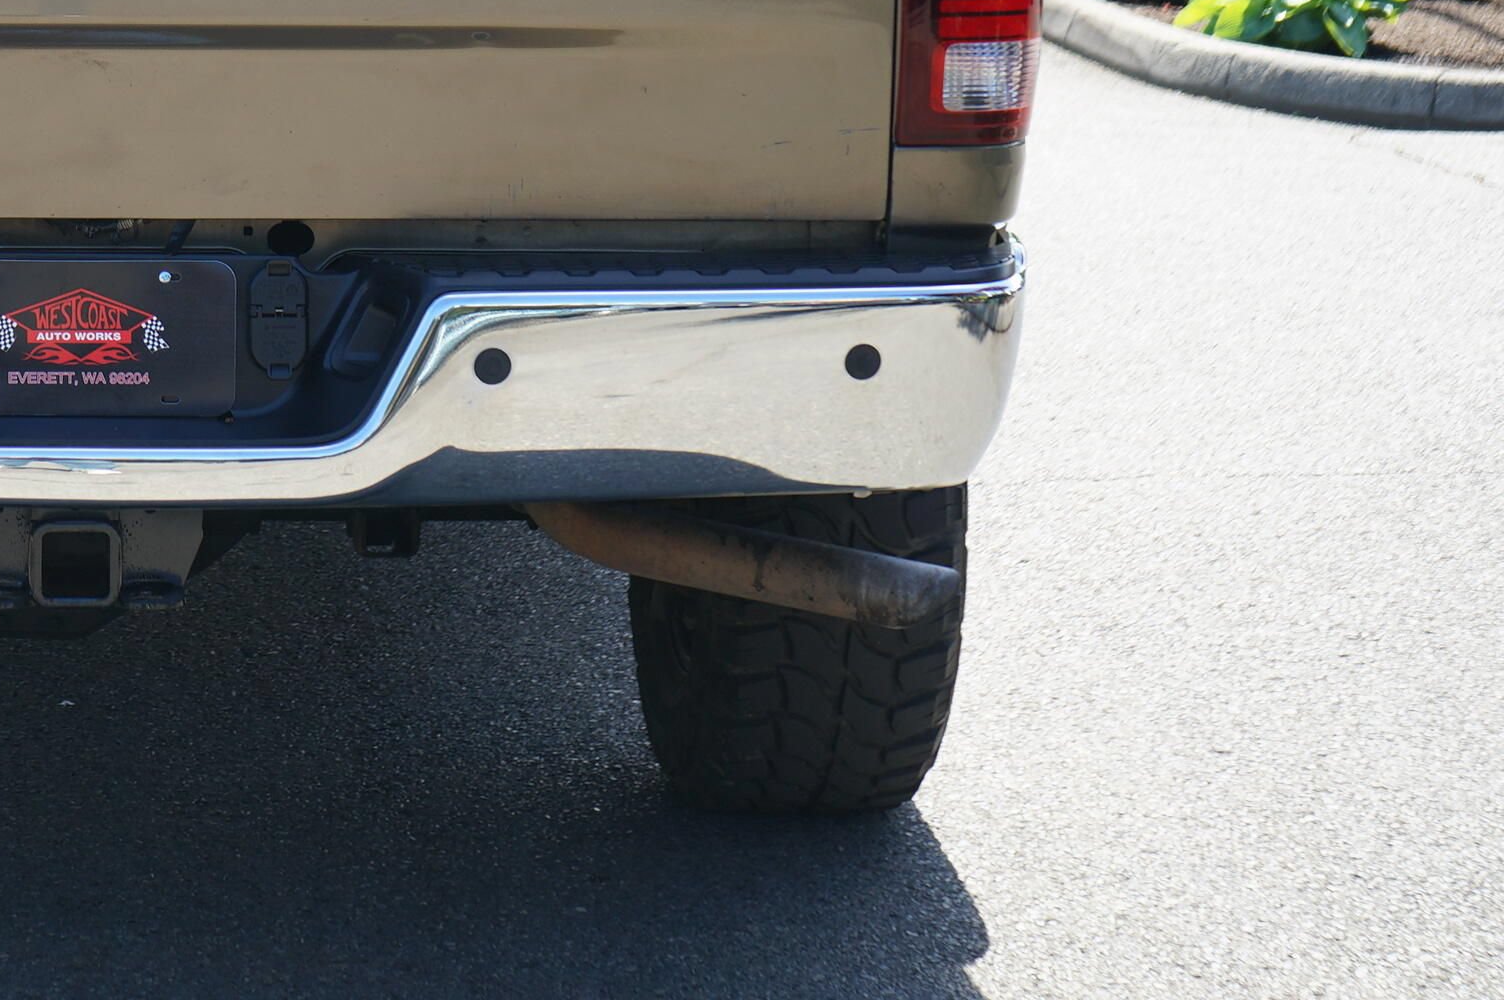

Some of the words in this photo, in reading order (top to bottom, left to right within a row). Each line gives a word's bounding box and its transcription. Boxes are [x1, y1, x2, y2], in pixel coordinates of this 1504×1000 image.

[36, 331, 71, 341] AUTO
[75, 331, 122, 341] WORKS
[7, 371, 79, 386] EVERETT,
[81, 371, 106, 385] WA
[109, 371, 150, 385] 98204
